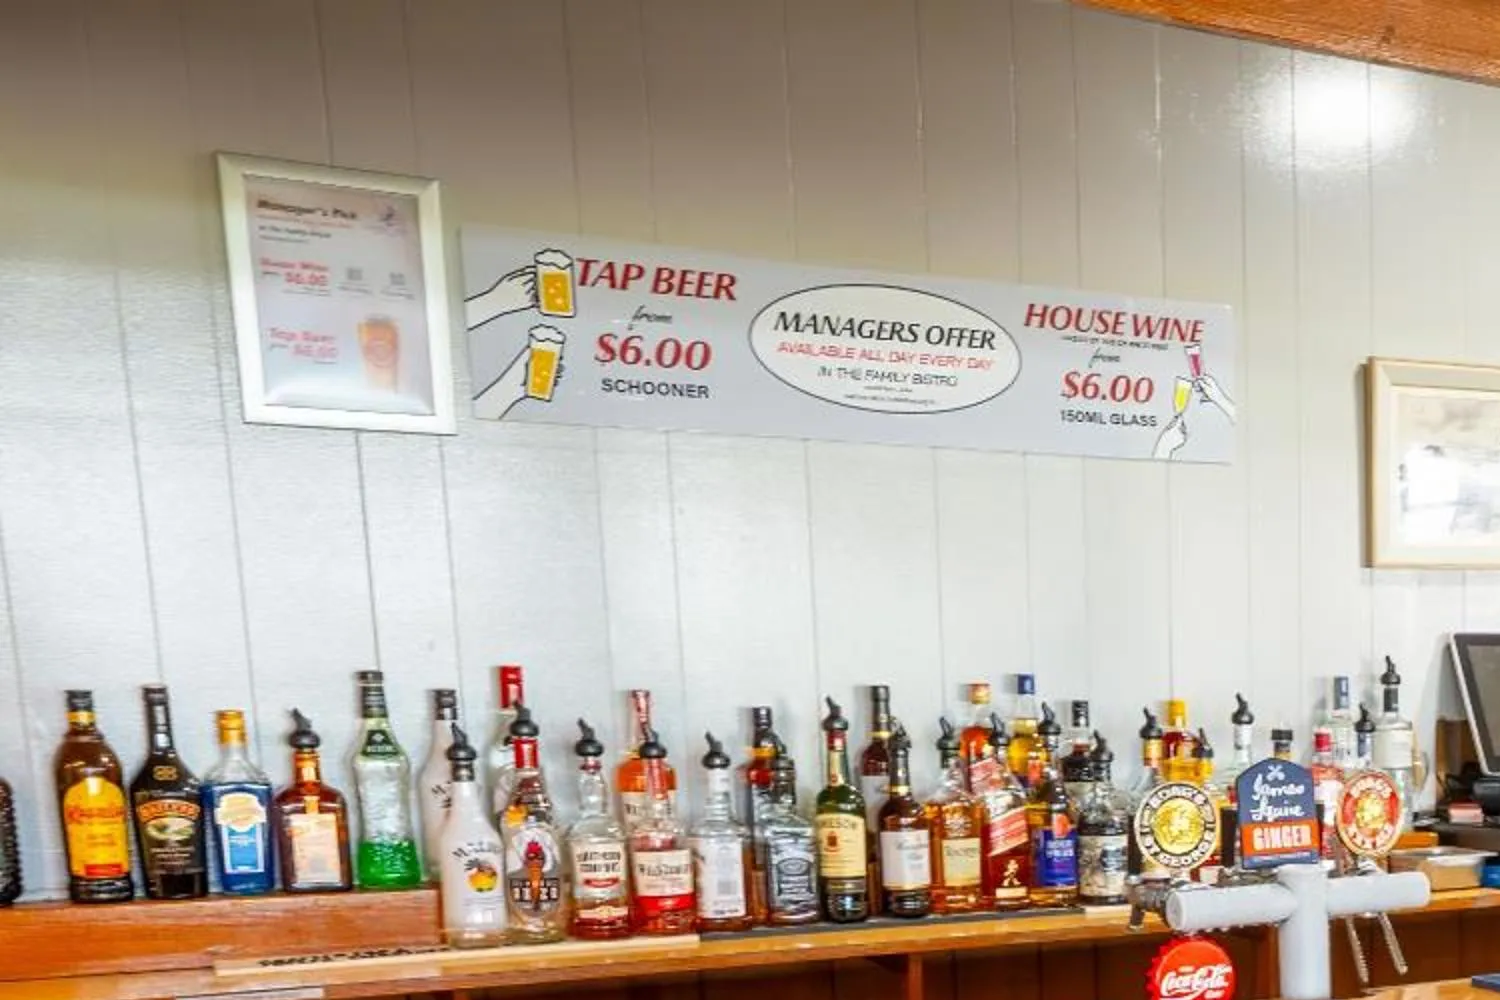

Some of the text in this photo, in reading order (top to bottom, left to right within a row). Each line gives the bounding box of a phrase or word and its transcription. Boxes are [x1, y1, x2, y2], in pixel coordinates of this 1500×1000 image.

[575, 257, 738, 301] TAP BEER
[627, 304, 673, 331] from
[773, 311, 997, 351] MANAGERS OFFER
[1023, 303, 1128, 336] HOUSE
[1131, 313, 1205, 344] WINE
[593, 333, 713, 372] $6.00
[776, 341, 995, 371] AVAILABLE ALL DAY EVERY DAY
[600, 377, 710, 400] SCHOONER
[864, 369, 910, 384] FAMILY
[1060, 370, 1155, 404] $6.00
[1060, 410, 1158, 427] 150ML GLASS
[1251, 773, 1305, 800] James
[1249, 797, 1305, 822] Squire
[1252, 824, 1313, 852] GINGER
